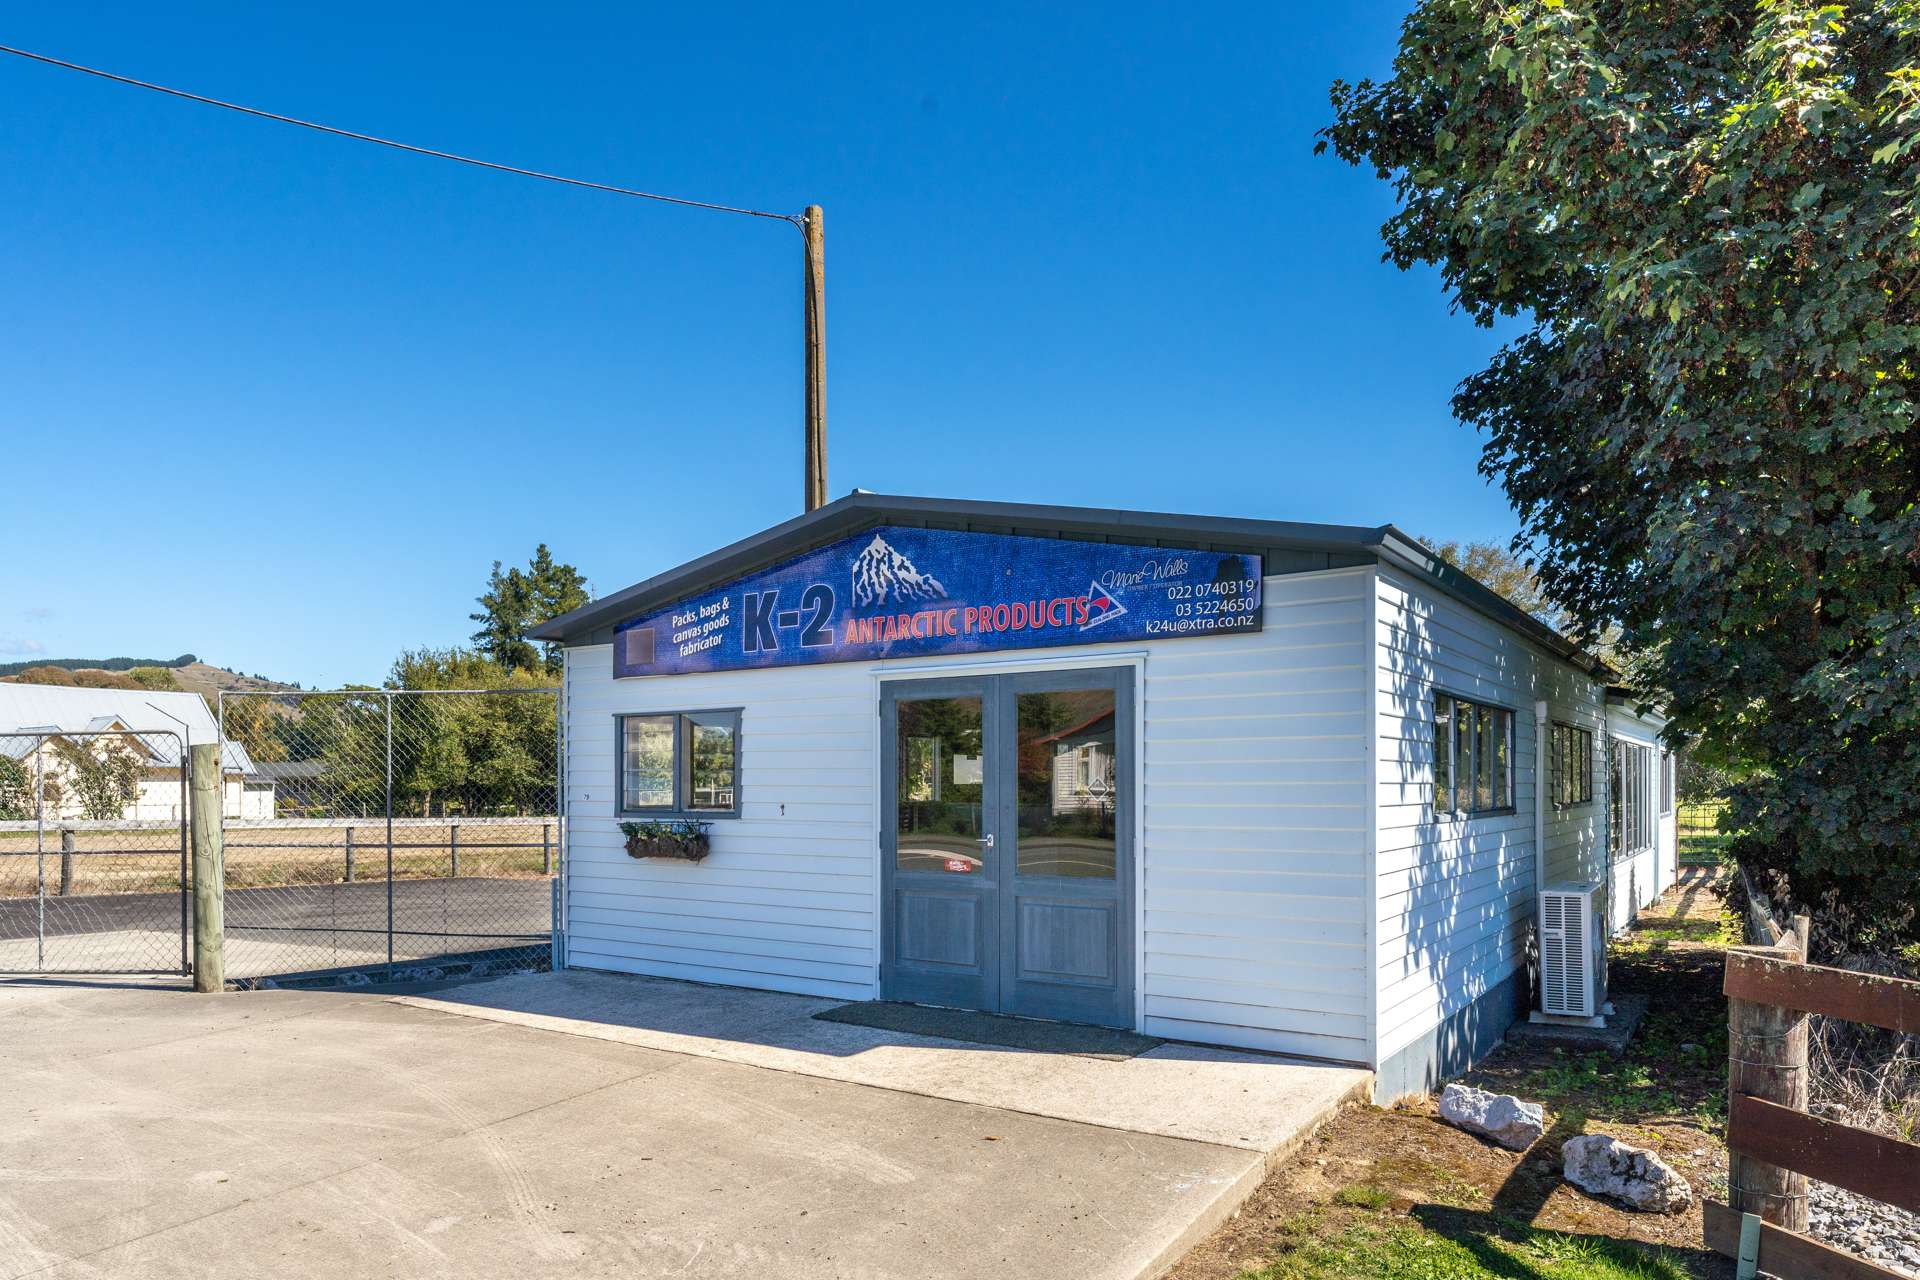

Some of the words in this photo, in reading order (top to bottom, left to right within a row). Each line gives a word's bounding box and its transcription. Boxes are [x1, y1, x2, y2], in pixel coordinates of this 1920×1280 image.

[1167, 585, 1192, 600] 022
[1195, 579, 1254, 598] 0740319
[672, 610, 698, 628] Packs,
[700, 602, 720, 618] bags
[722, 596, 730, 610] &
[743, 583, 836, 653] K-2
[845, 608, 957, 644] ANTARCTIC
[964, 595, 1089, 634] PRODUCTS
[1175, 603, 1191, 617] 03
[1195, 597, 1254, 615] 5224650
[672, 625, 702, 643] canvas
[703, 613, 730, 636] goods
[1146, 615, 1254, 633] k24u@xtra.co.nz
[679, 633, 723, 657] fabricator
